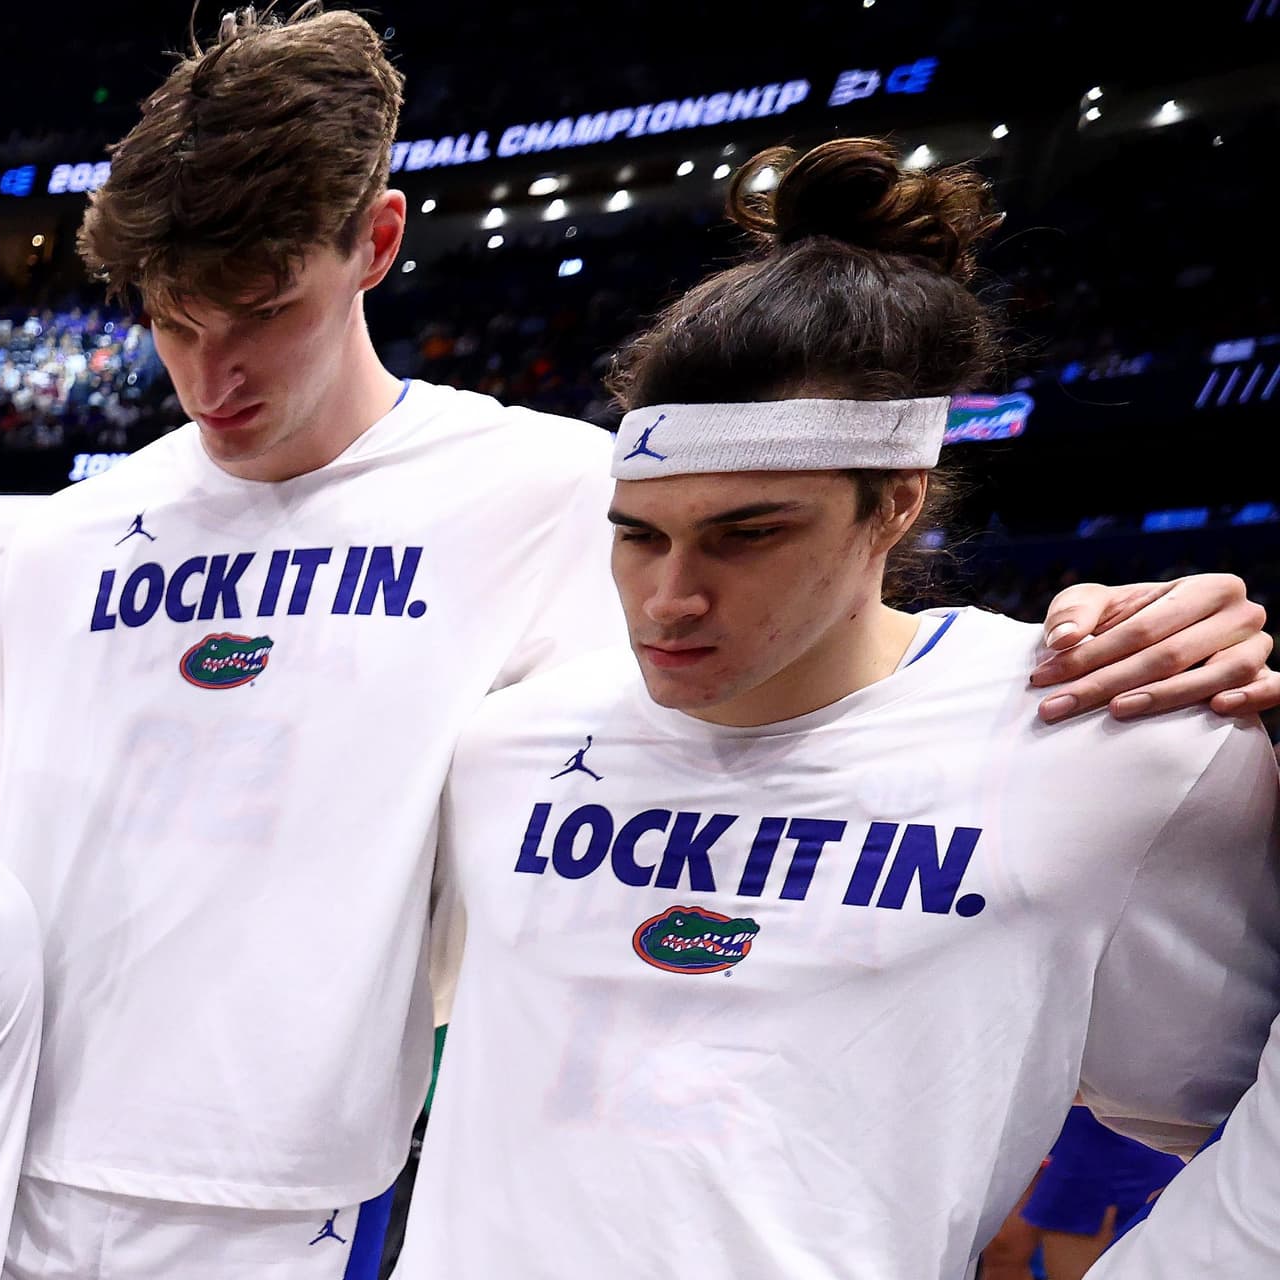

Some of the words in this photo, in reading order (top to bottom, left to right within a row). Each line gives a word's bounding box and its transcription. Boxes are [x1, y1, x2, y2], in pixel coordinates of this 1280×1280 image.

[47, 161, 112, 194] 202
[497, 78, 811, 159] CHAMPIONSHIP
[90, 552, 256, 632] LOCK
[257, 547, 333, 617] IT
[331, 546, 427, 618] IN.
[513, 802, 738, 893] LOCK
[736, 816, 847, 901] IT
[842, 821, 986, 918] IN.
